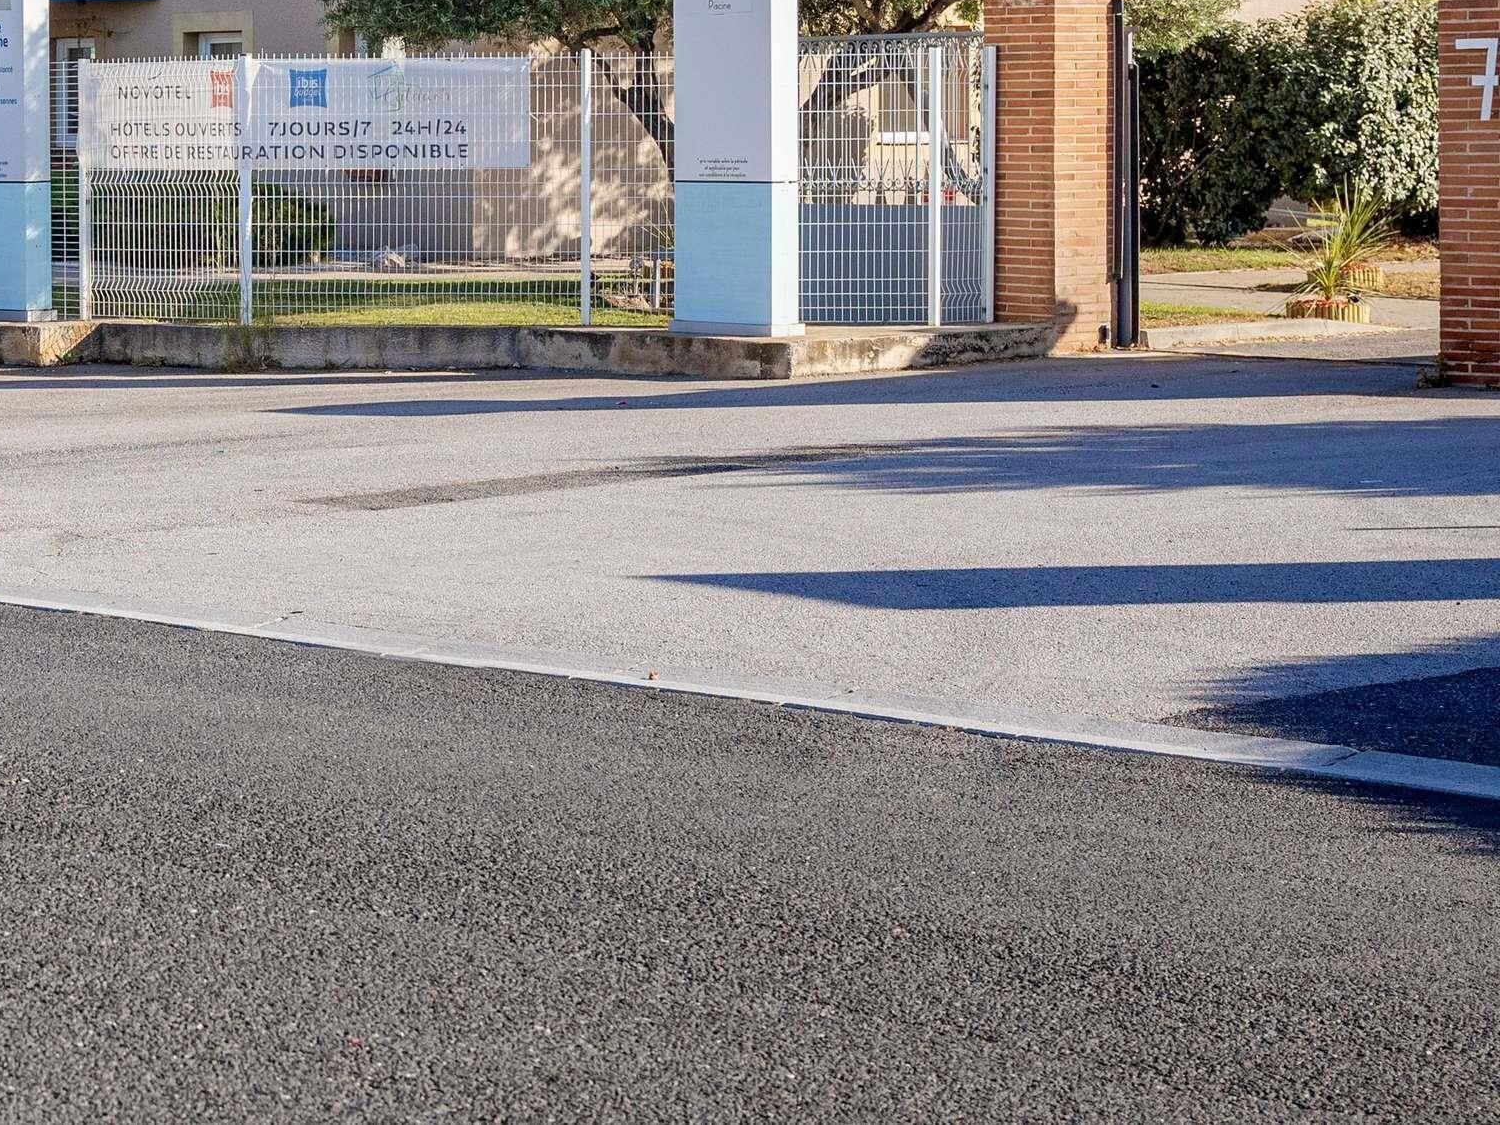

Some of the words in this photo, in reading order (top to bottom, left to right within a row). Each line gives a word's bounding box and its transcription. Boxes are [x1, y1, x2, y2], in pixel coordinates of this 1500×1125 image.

[296, 76, 319, 88] ibis
[1455, 37, 1499, 122] 7
[118, 85, 192, 100] NOVOTEL
[175, 122, 242, 137] OUVERTS
[392, 118, 467, 136] 24H/24
[110, 145, 158, 160] OFFRE
[163, 145, 183, 160] DE
[187, 145, 325, 161] RESTAURATION
[334, 144, 469, 159] DISPONIBLE
